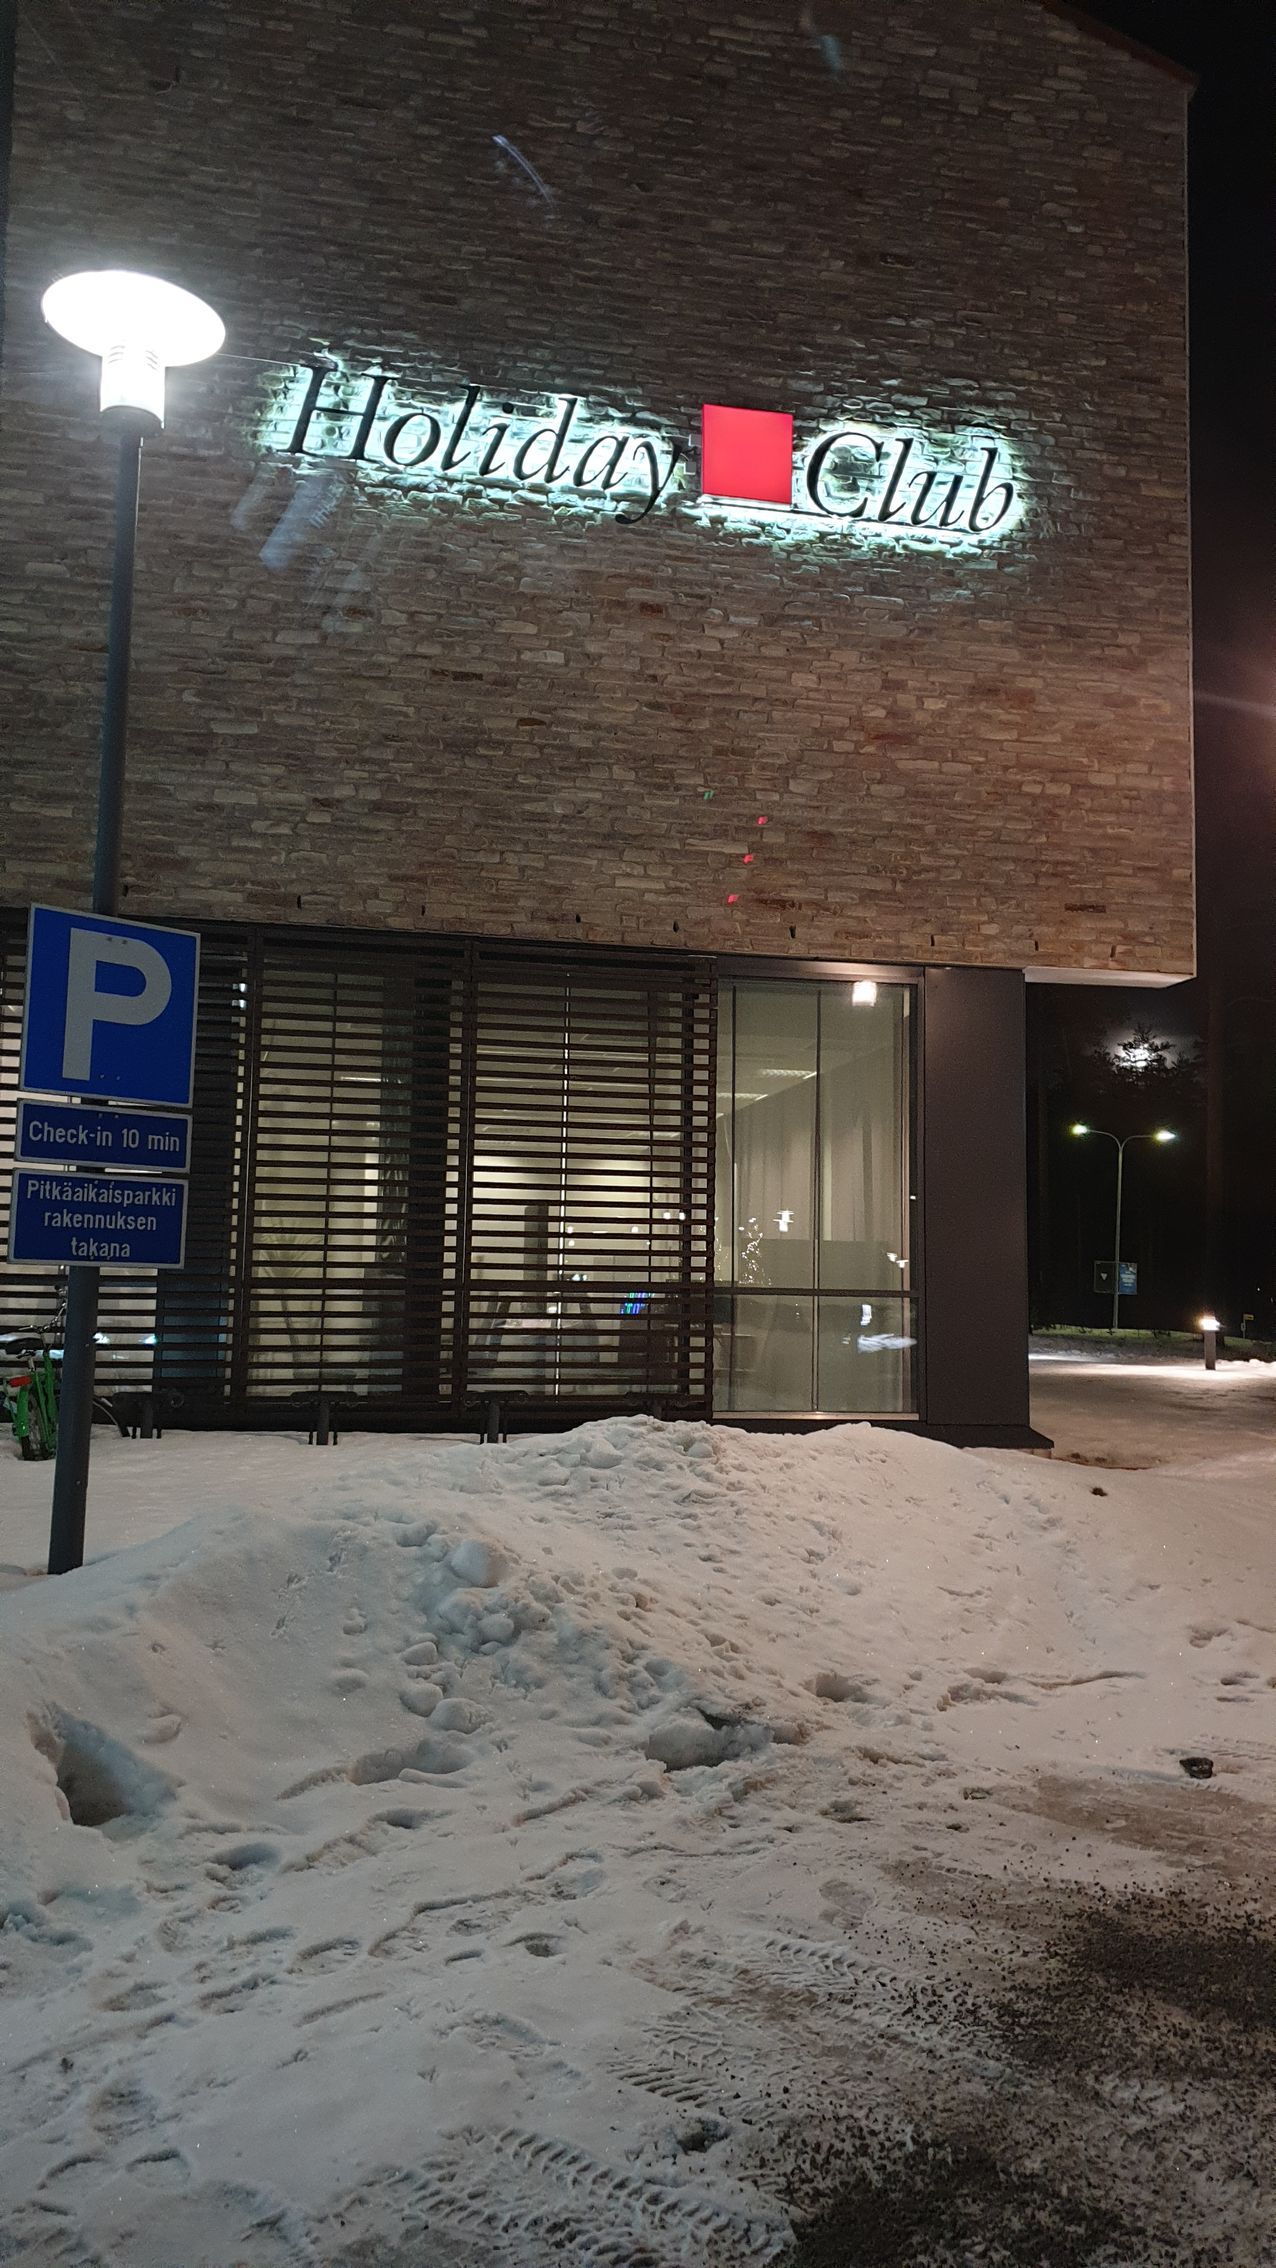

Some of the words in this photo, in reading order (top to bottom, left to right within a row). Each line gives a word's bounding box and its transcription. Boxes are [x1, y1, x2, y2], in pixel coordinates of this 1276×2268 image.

[277, 364, 686, 524] Holiday
[807, 431, 1014, 533] Club
[62, 928, 172, 1081] P
[29, 1121, 112, 1147] Check-in
[121, 1129, 139, 1149] 10
[148, 1132, 180, 1152] min
[27, 1180, 176, 1207] Pitkäaikaisparkki
[44, 1211, 157, 1231] rakennuksen
[70, 1236, 131, 1260] takana
